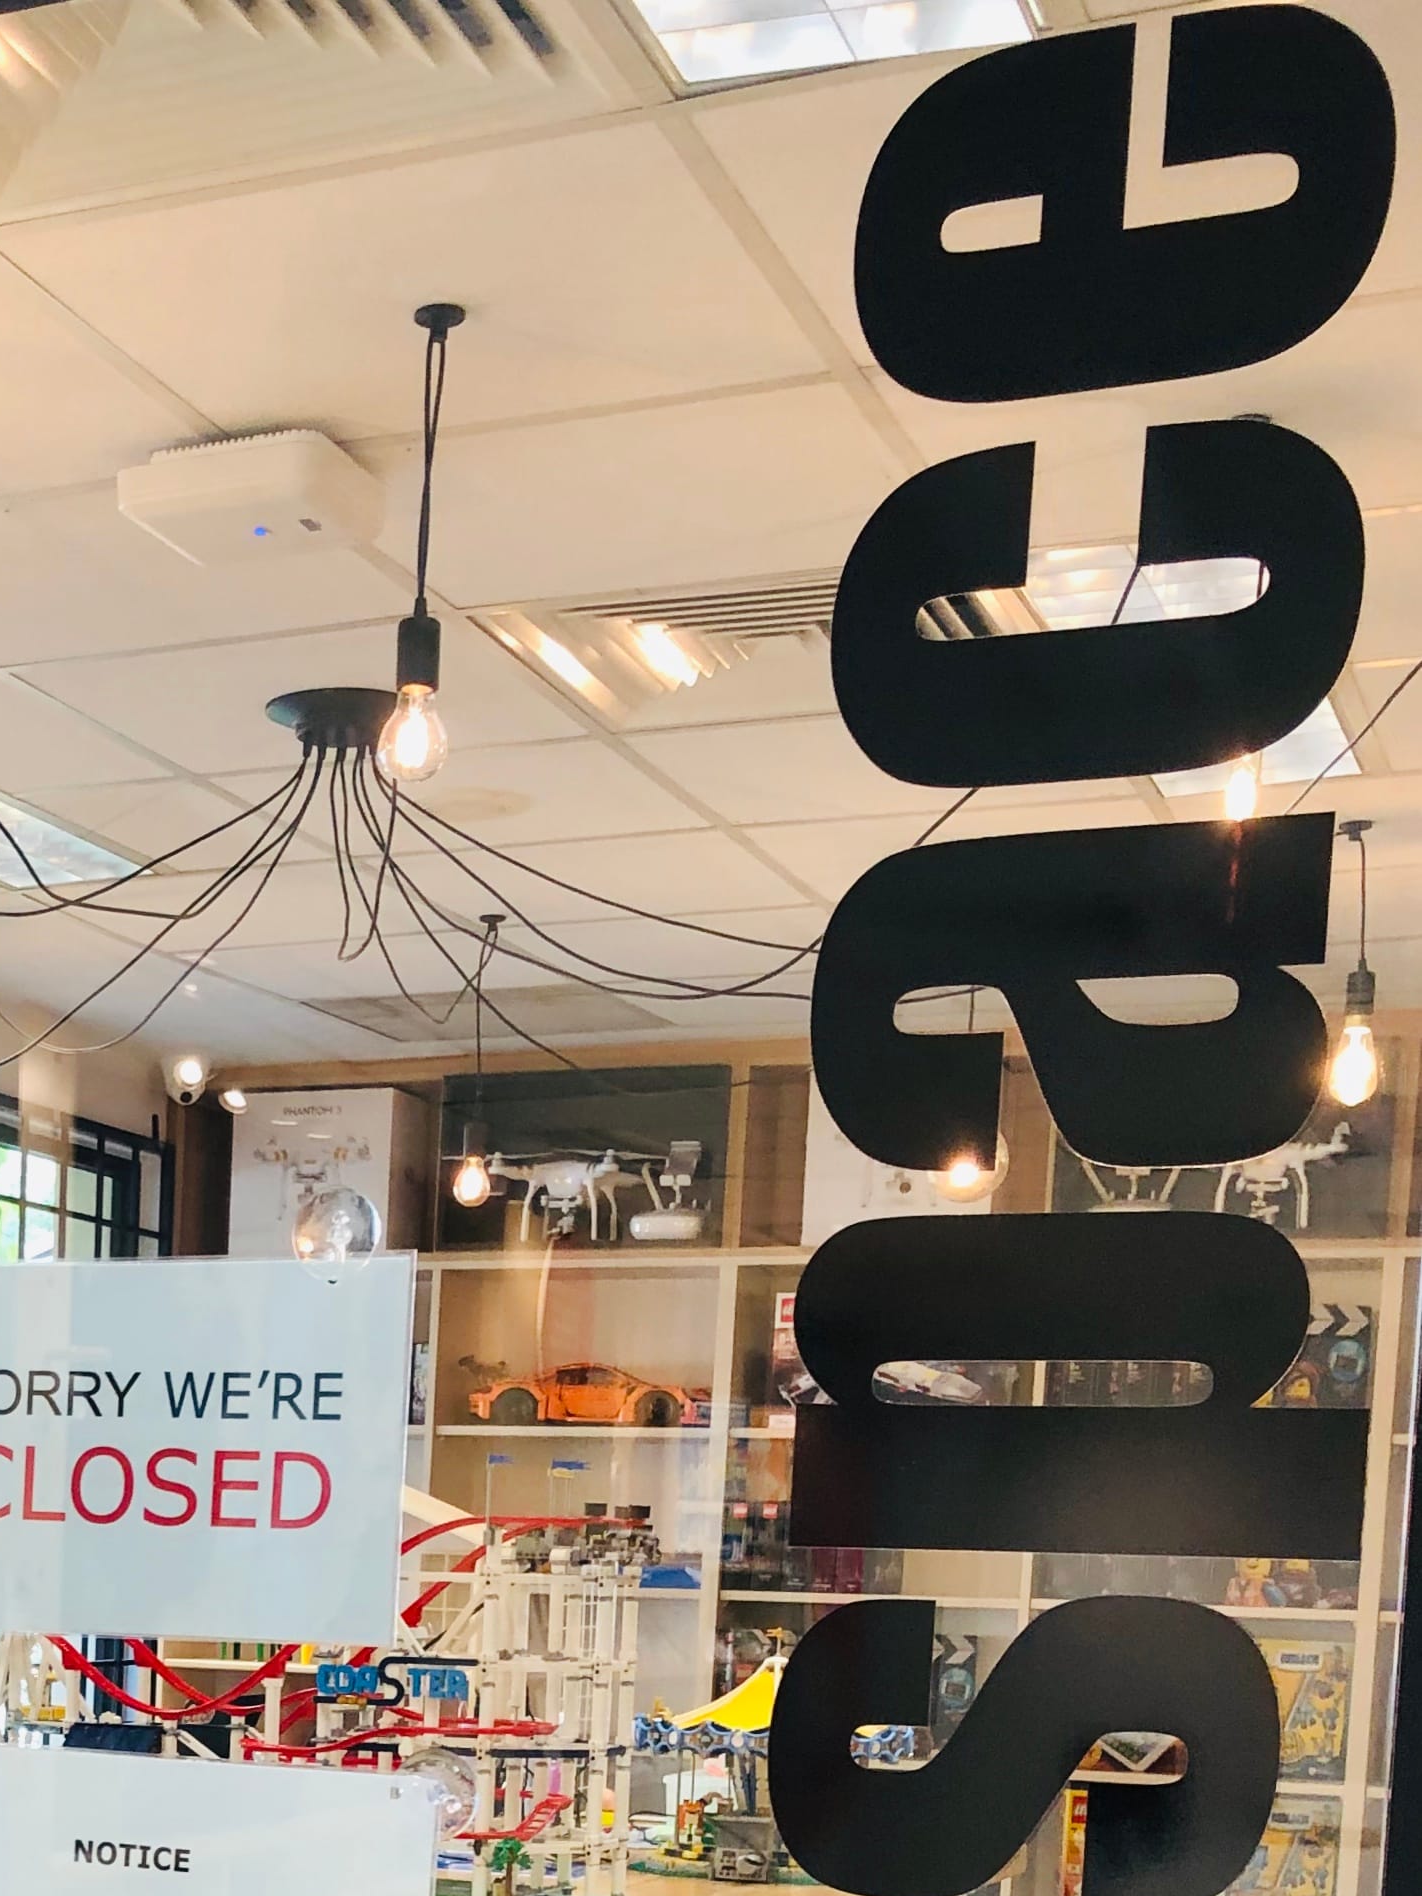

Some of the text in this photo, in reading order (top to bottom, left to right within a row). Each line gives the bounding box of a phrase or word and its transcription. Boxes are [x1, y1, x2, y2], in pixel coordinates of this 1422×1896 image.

[164, 1370, 344, 1422] WE'RE
[316, 1657, 468, 1705] COASTER
[73, 1839, 191, 1873] NOTICE
